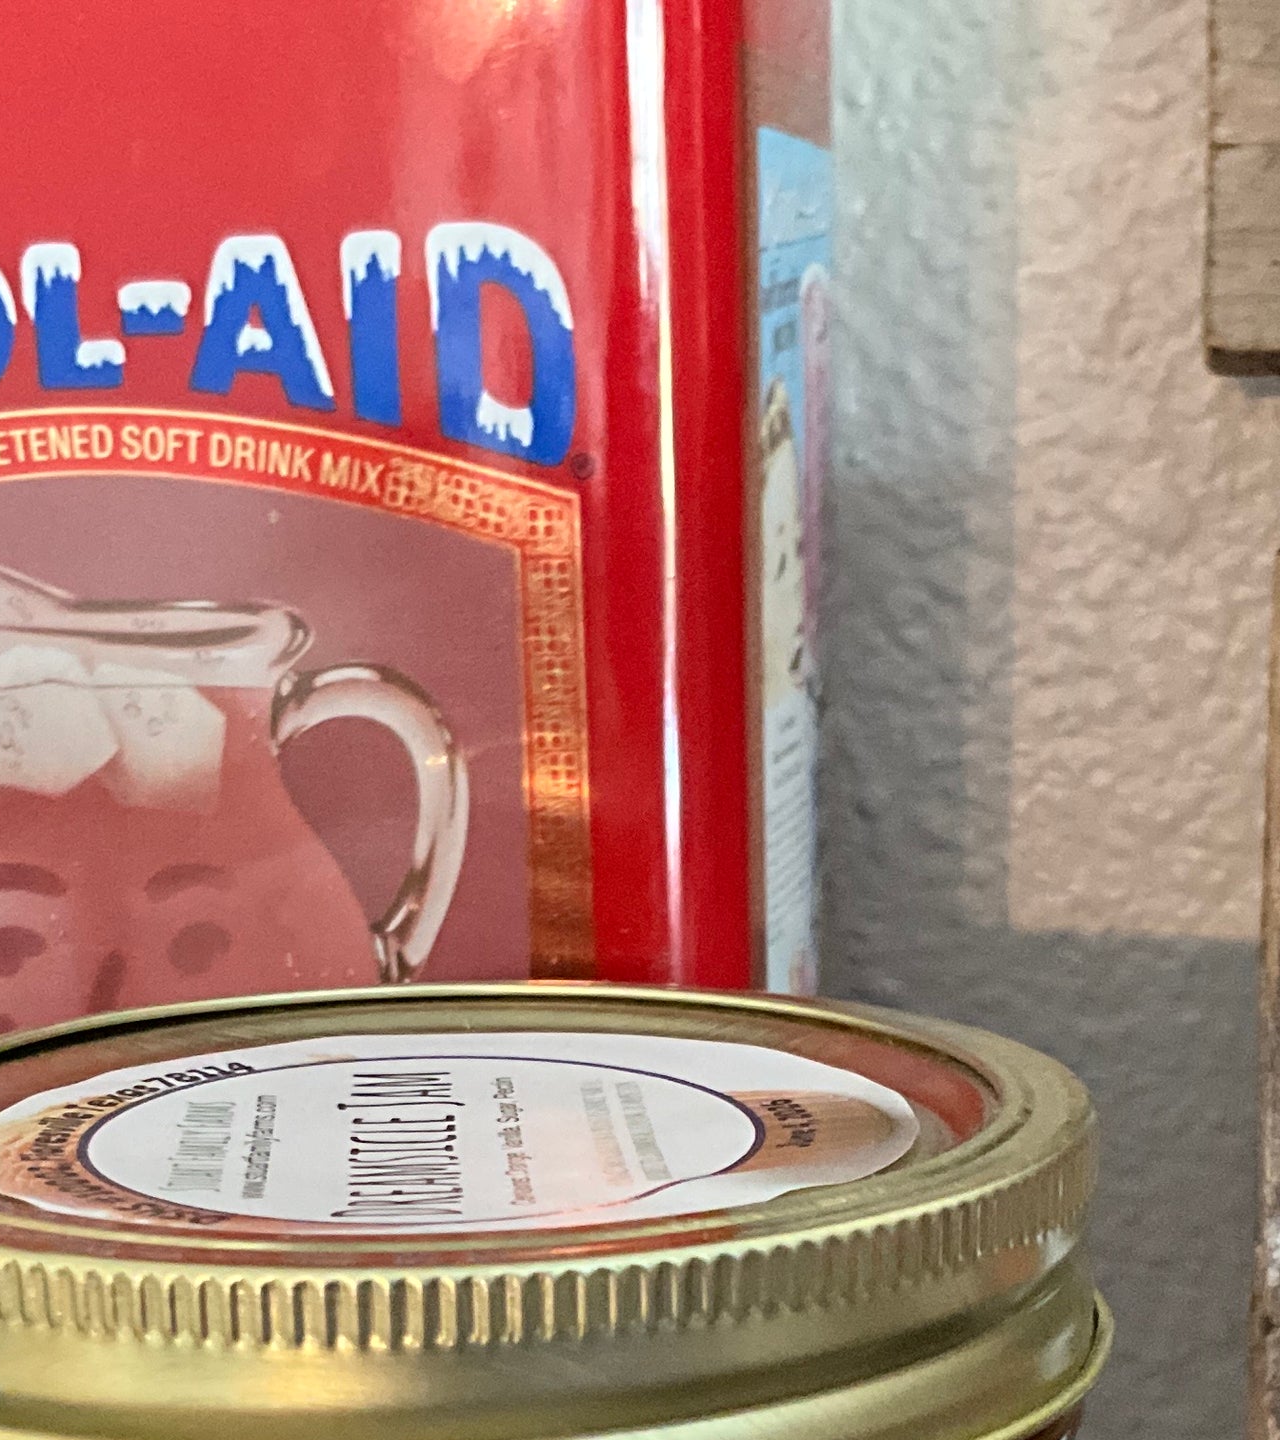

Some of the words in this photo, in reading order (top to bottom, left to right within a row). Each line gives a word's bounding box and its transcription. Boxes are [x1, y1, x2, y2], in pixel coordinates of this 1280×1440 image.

[121, 425, 204, 463] SOFT
[209, 433, 314, 481] DRINK
[320, 451, 384, 497] MIX
[141, 1061, 255, 1088] 78114
[337, 1072, 465, 1110] JAM
[330, 1115, 463, 1217] DREAMSICLE
